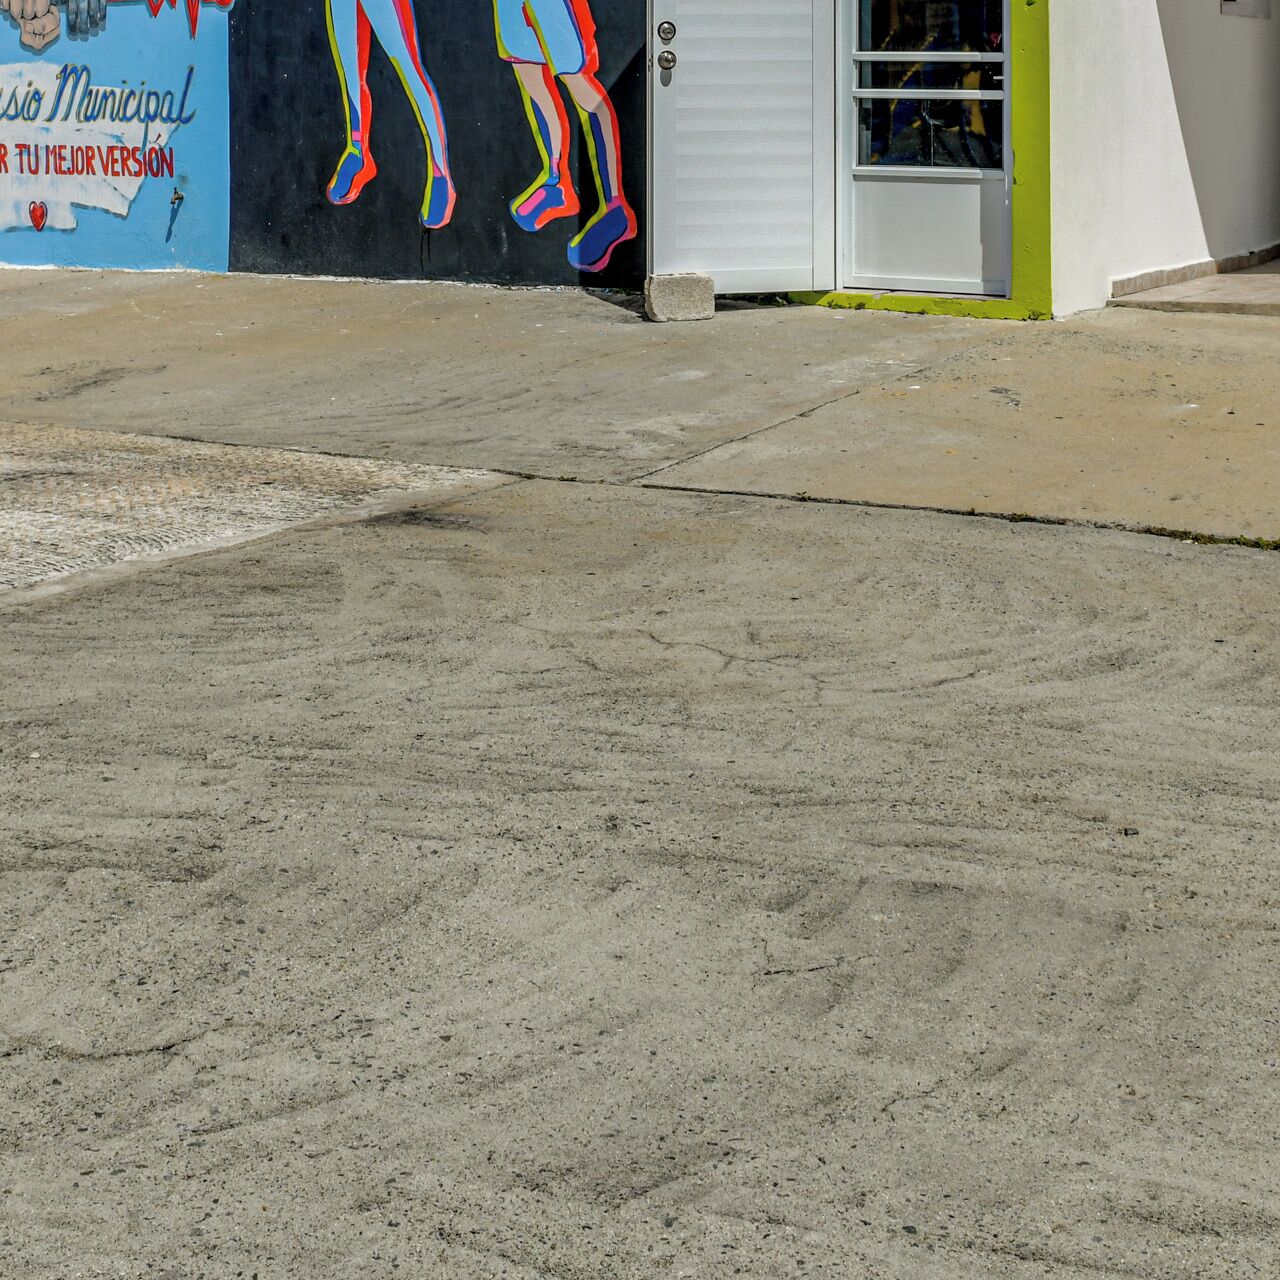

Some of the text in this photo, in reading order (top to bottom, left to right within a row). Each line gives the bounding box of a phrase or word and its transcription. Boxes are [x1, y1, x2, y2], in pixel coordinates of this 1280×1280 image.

[43, 64, 196, 155] Municipal
[15, 142, 40, 175] TU
[45, 144, 96, 176] MEJOR
[96, 133, 175, 178] VERSIÓN
